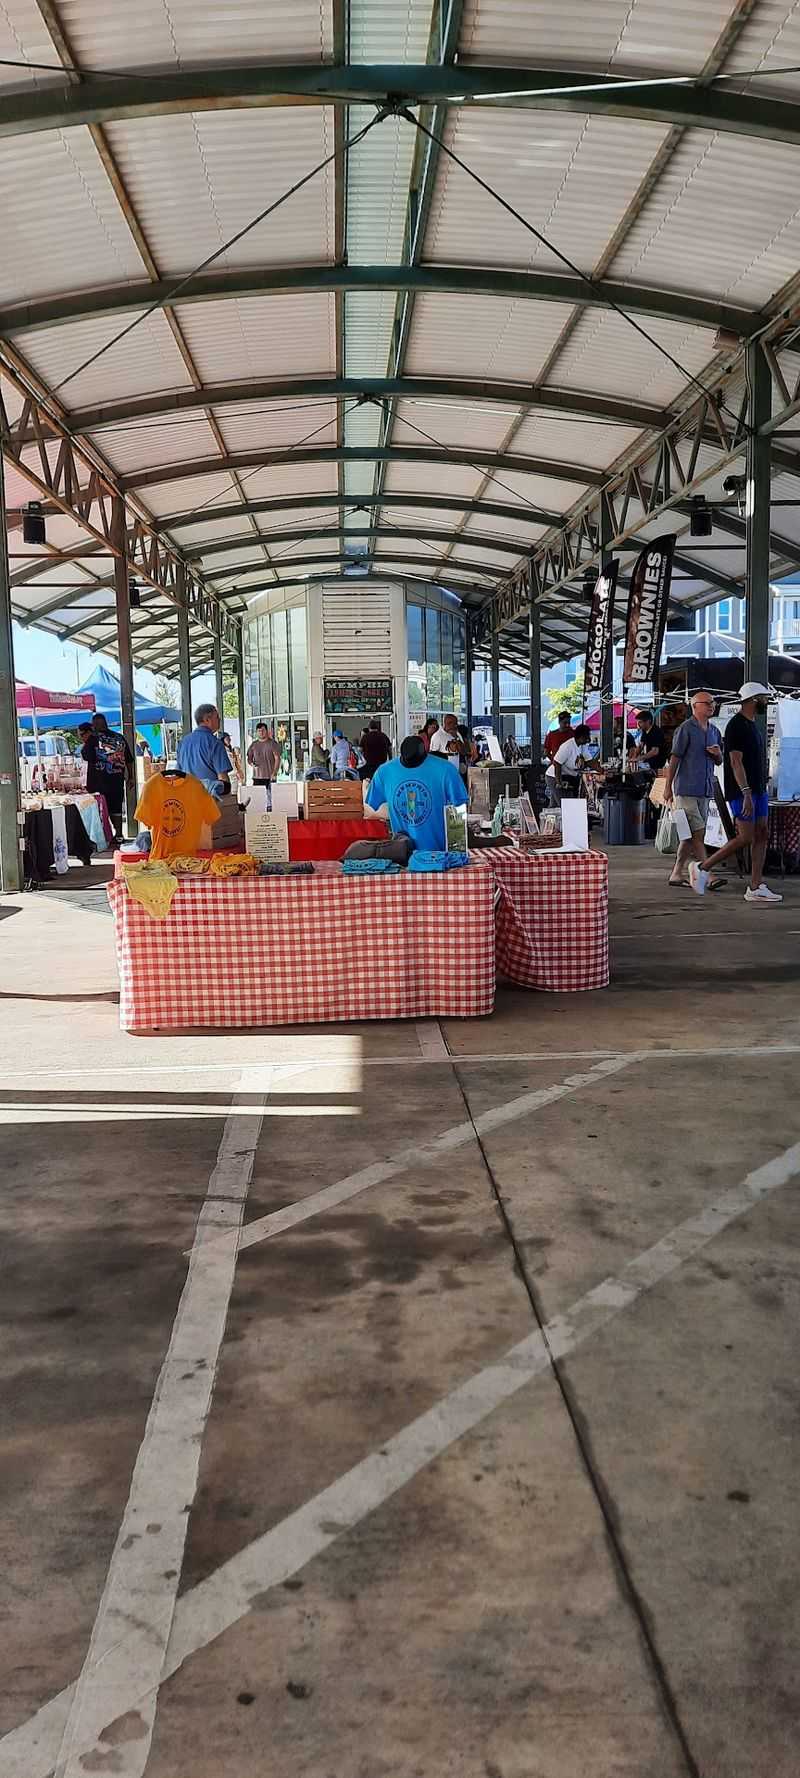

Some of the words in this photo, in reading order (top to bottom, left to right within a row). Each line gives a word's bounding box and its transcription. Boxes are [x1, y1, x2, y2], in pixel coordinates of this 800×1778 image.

[591, 577, 610, 687] CHOCOLATE
[631, 552, 661, 680] BROWNIES
[326, 681, 390, 689] MEMPHIS
